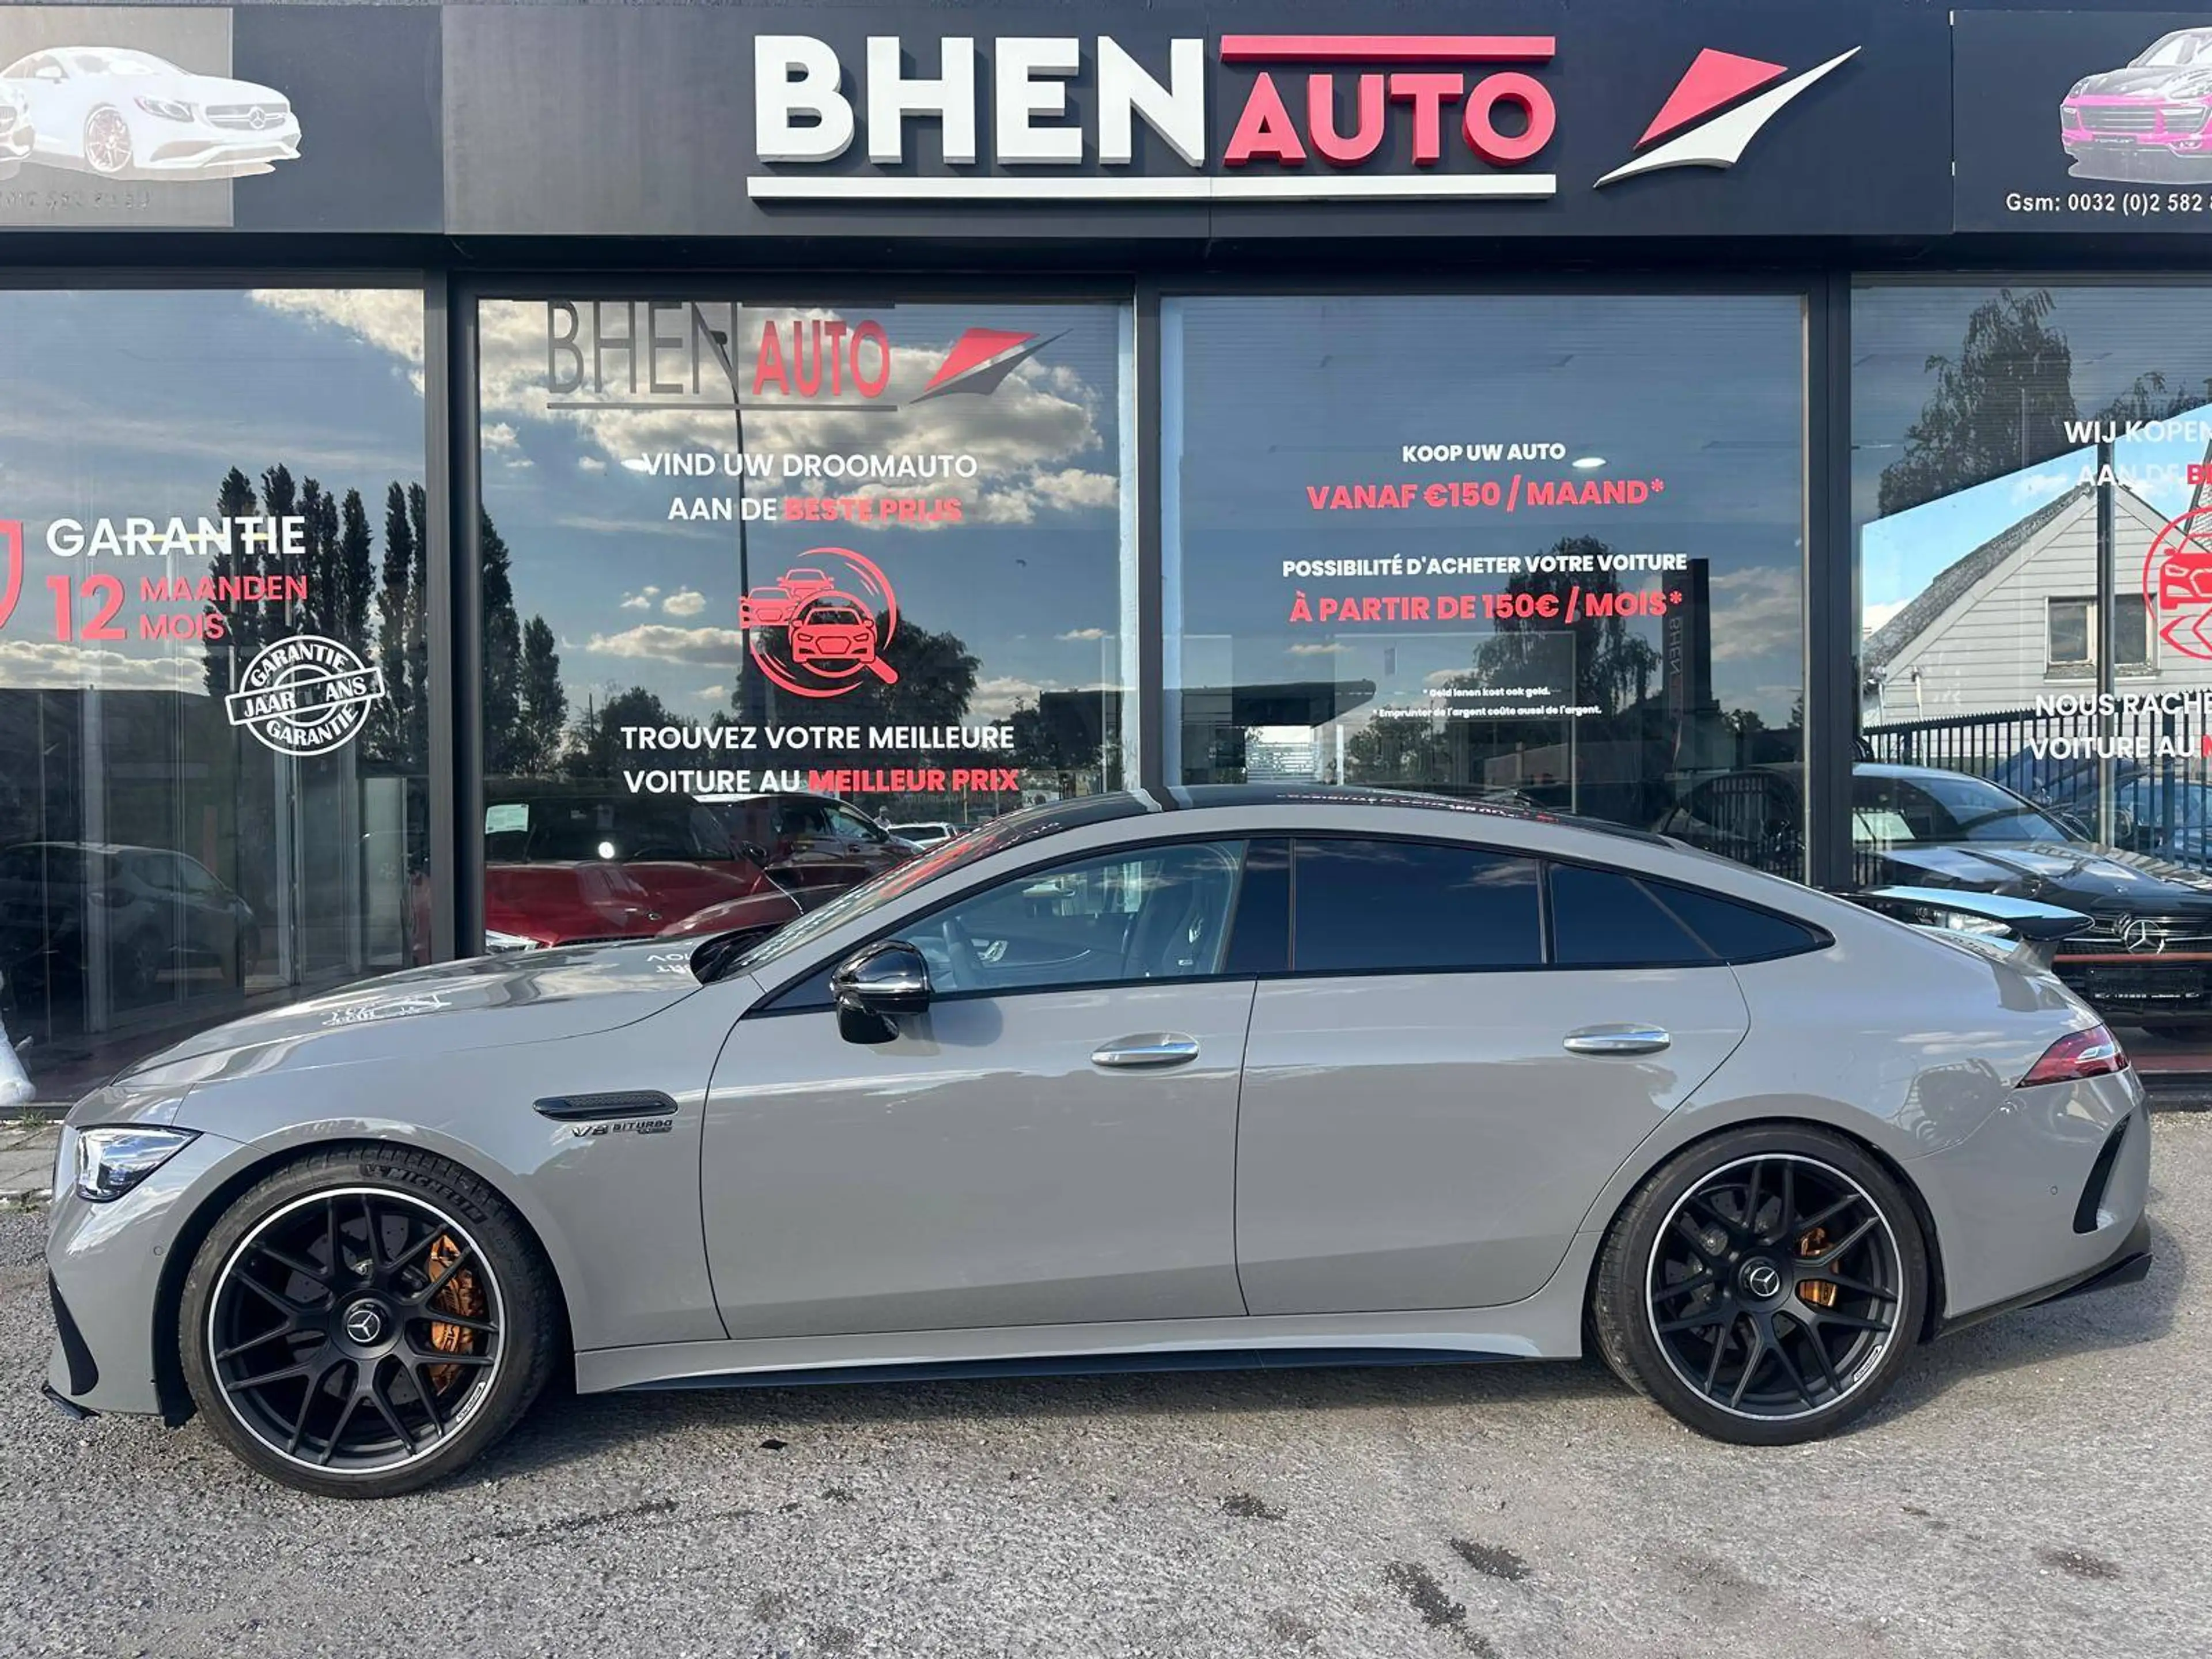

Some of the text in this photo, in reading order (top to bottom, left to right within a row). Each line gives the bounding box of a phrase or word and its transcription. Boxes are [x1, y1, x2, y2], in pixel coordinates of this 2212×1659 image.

[755, 35, 1556, 168] BHEN AUTO
[2006, 193, 2060, 211] Gsm:
[2067, 193, 2115, 211] 0032
[2122, 193, 2160, 216] (0)2
[2167, 193, 2202, 211] 582
[547, 301, 891, 398] BHEN AUTO
[2064, 421, 2116, 443] WIJ
[643, 453, 978, 478] VIND UW DROOMAUTO
[1403, 443, 1566, 463] KOOP UW AUTO
[1308, 484, 1418, 510] VANAF
[1423, 482, 1501, 509] €150
[1506, 474, 1522, 513] /
[668, 497, 961, 522] AAN DE BESTE PRIJS
[46, 516, 306, 557] GARANTIE
[1283, 553, 1688, 578] POSSIBILITÉ D'ACHETER VOTRE VOITURE
[140, 574, 308, 602] MAANDEN
[46, 574, 127, 642] 12
[1289, 590, 1312, 623] À
[1319, 595, 1430, 621] PARTIR
[1437, 594, 1476, 620] DE
[1481, 593, 1559, 619] 150€
[1565, 586, 1580, 624] /
[140, 612, 225, 640] MOIS
[250, 643, 349, 687] GARANTIE
[244, 676, 368, 718] JAAR ANS
[1505, 687, 1525, 696] ook
[1545, 705, 1559, 715] de
[2035, 692, 2115, 717] NOUS
[266, 704, 359, 747] GARANTIE
[620, 725, 1014, 750] TROUVEZ VOTRE MEILLEURE
[2029, 736, 2149, 760] VOITURE
[2156, 735, 2195, 758] AU
[623, 768, 1019, 793] VOITURE AU MEILLEUR PRIX
[571, 1125, 609, 1137] V8
[612, 1119, 673, 1132] BITURBO
